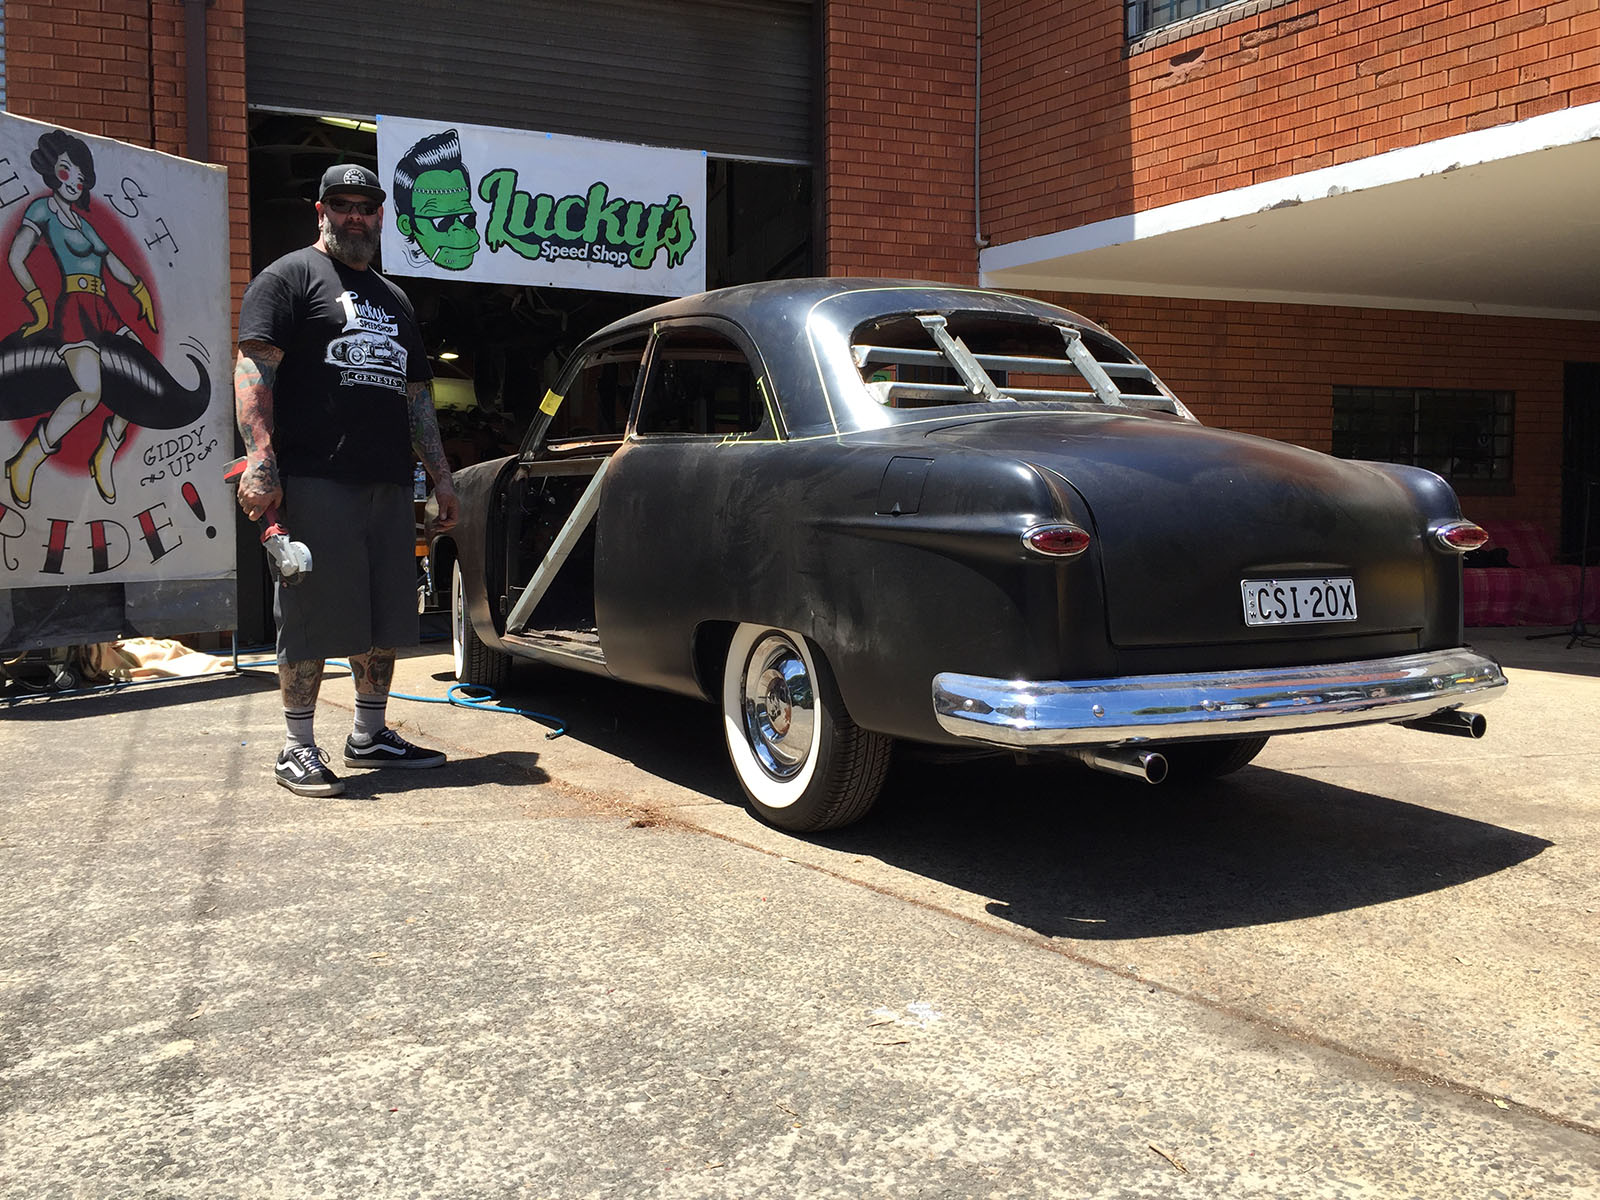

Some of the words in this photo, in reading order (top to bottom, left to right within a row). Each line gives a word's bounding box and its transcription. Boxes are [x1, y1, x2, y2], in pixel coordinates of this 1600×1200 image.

[478, 168, 697, 269] Lucky's
[540, 240, 588, 261] Speed
[591, 244, 629, 267] Shop
[335, 291, 396, 330] Lucky's
[354, 373, 399, 387] GENESIS
[143, 425, 206, 467] GIDDY
[168, 455, 197, 478] UP
